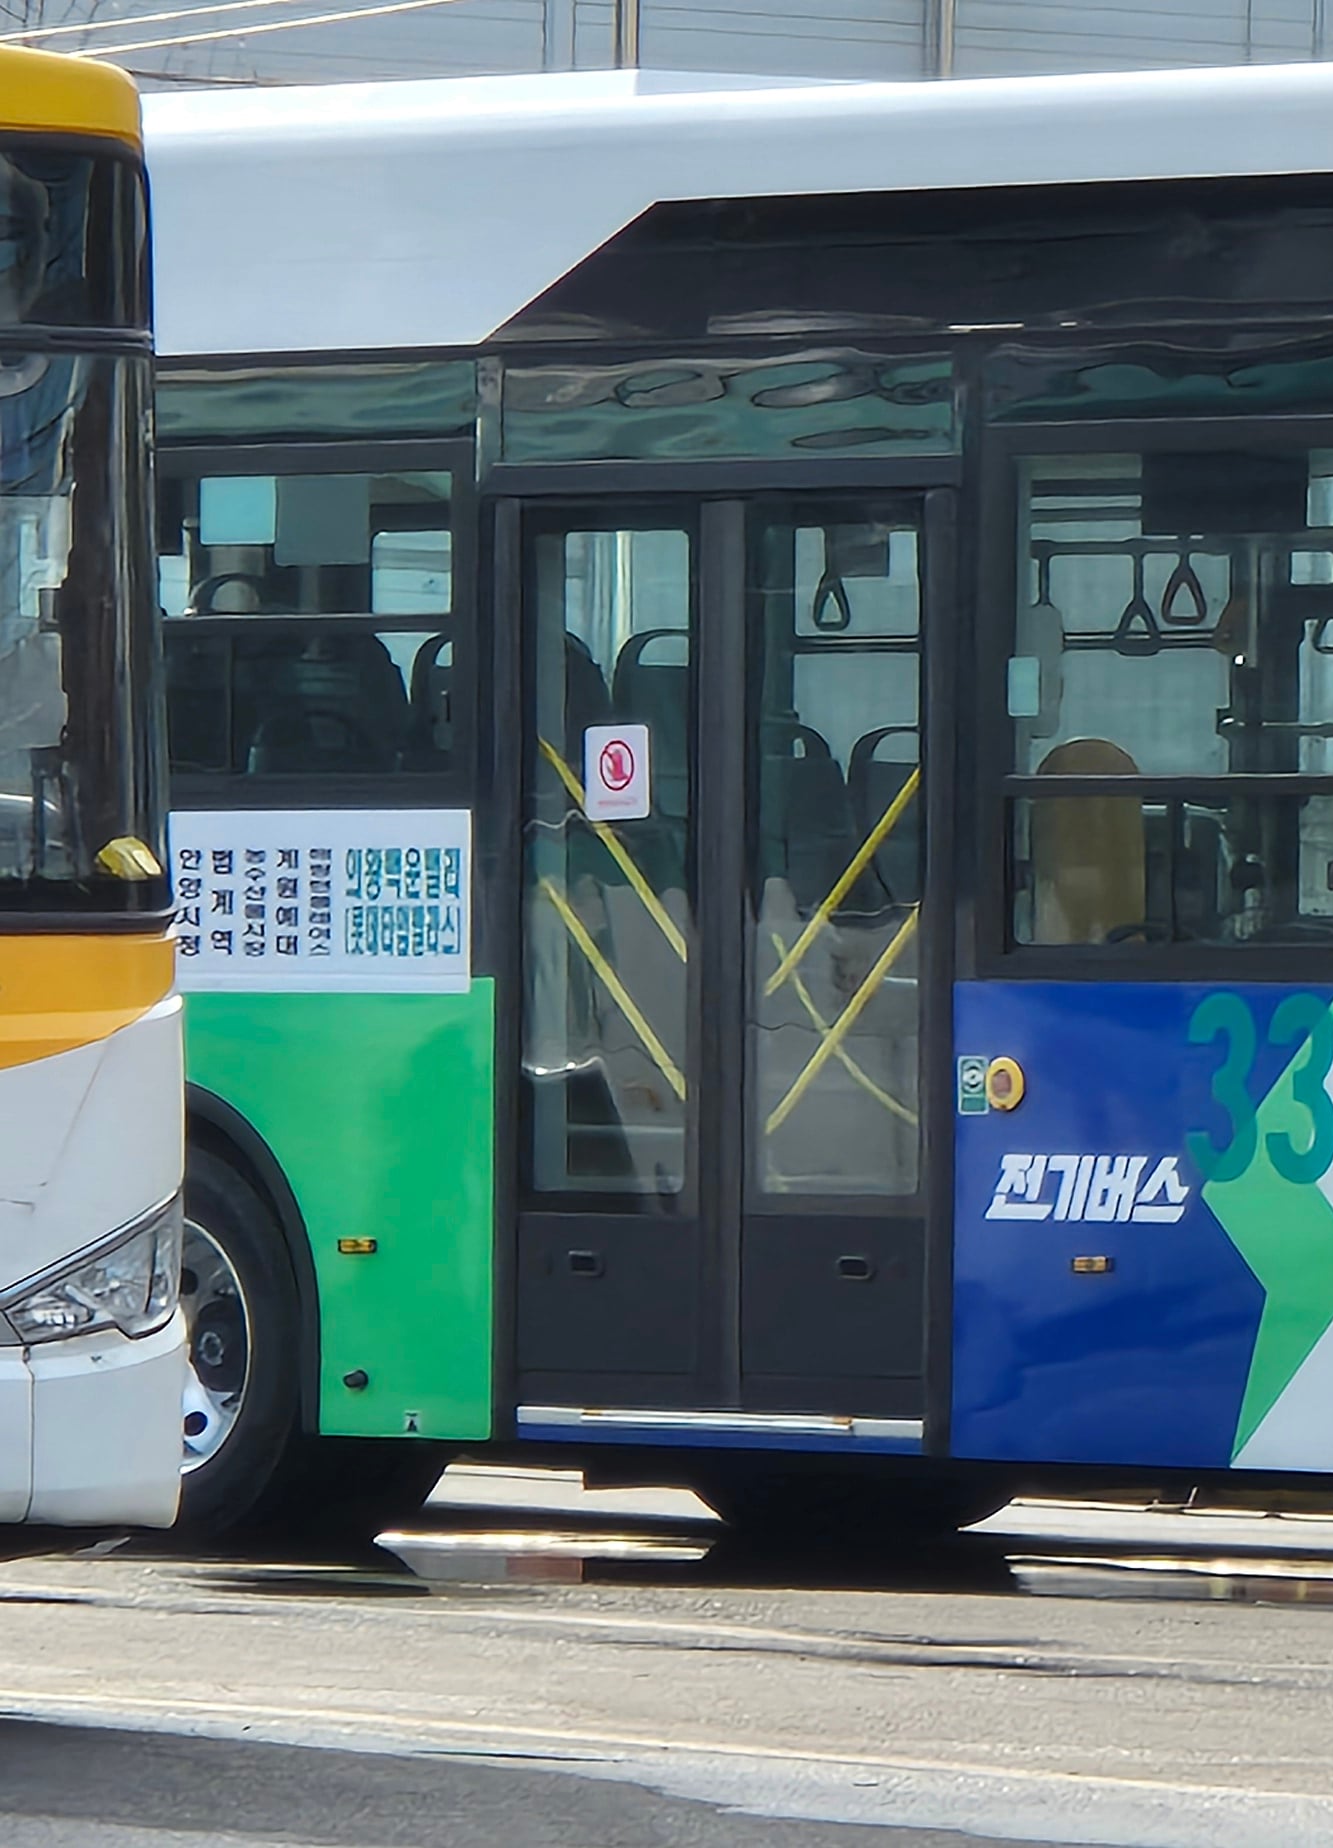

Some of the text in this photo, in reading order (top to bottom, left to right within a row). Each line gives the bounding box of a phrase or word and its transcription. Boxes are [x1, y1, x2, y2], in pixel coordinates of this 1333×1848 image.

[210, 849, 233, 955] 범계역
[275, 848, 298, 955] 계원예대
[984, 1153, 1190, 1223] 전기버스
